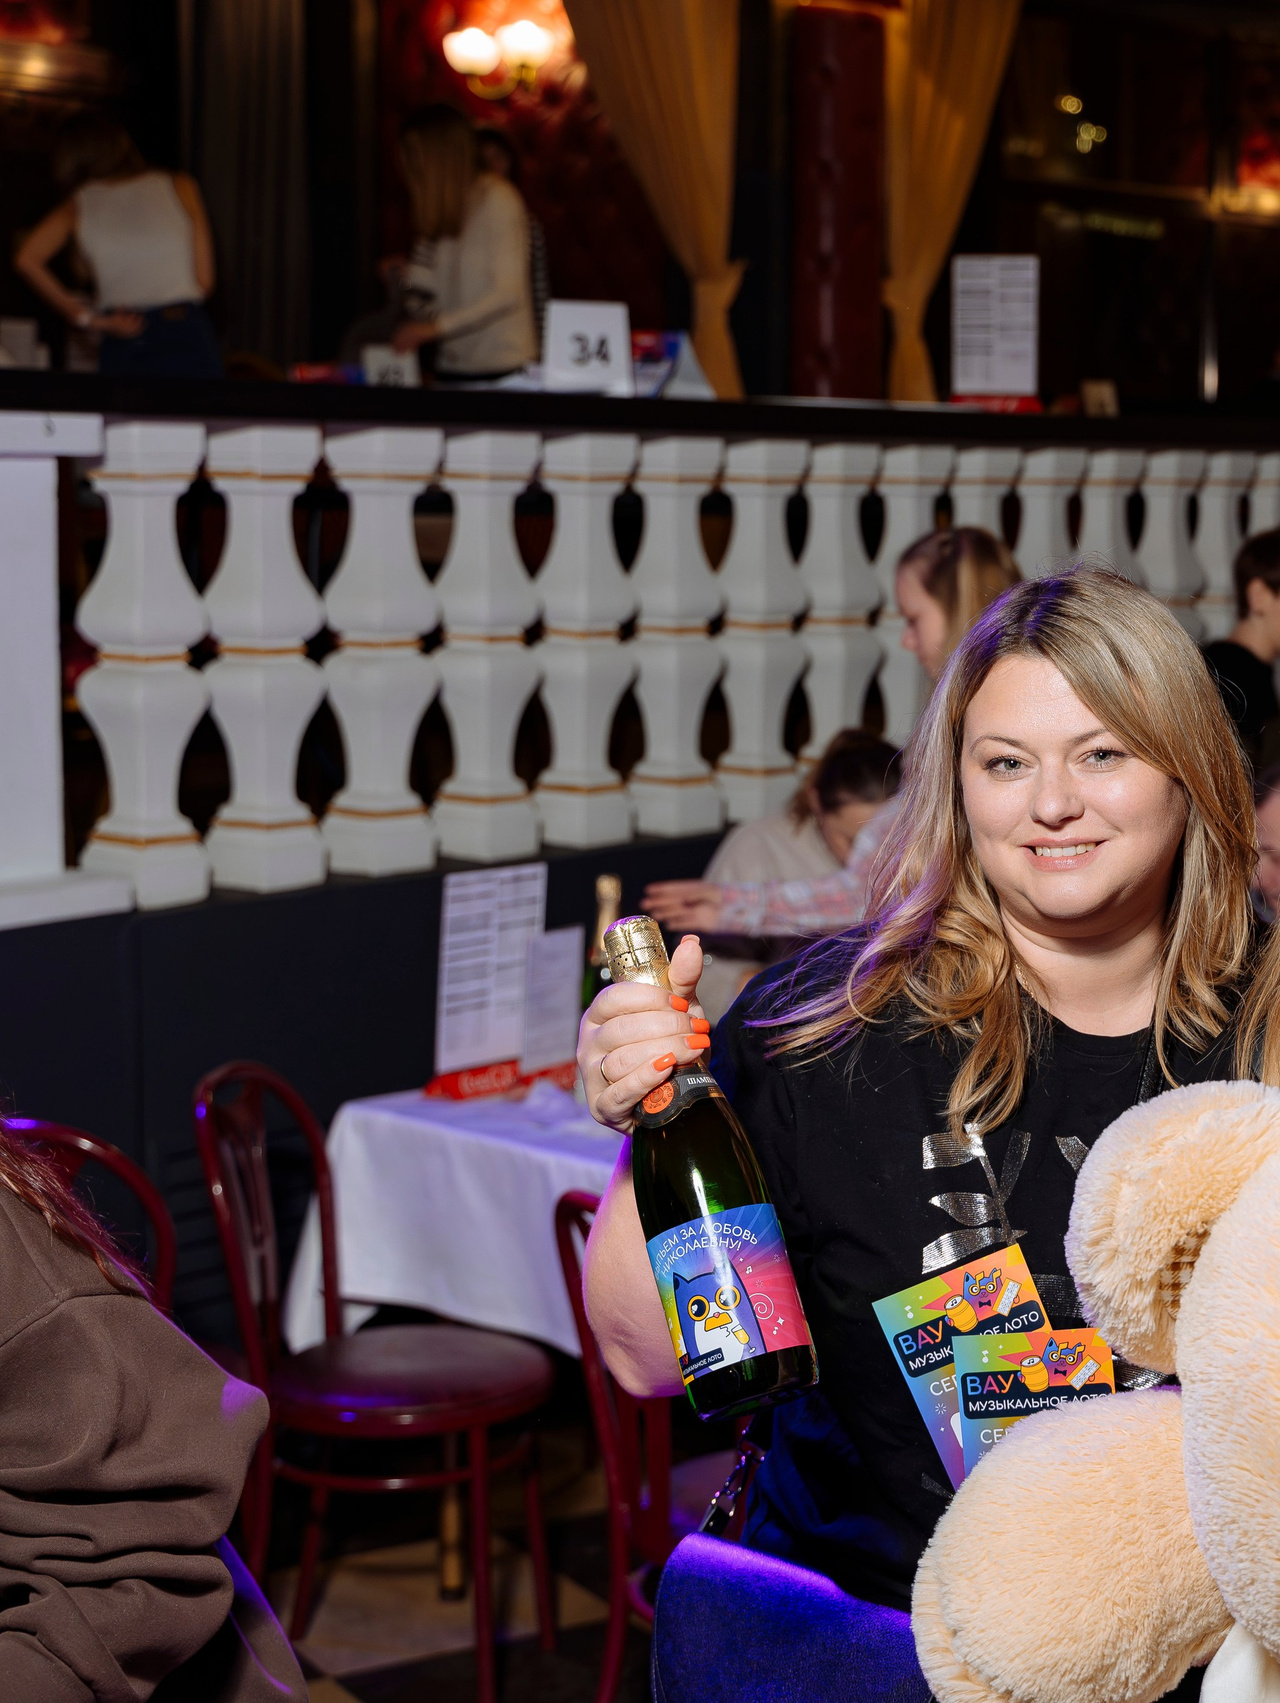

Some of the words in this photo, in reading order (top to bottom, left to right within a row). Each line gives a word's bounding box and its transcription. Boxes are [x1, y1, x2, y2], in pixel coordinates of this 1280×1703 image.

[570, 332, 611, 366] 34
[679, 1226, 697, 1240] ЗА
[661, 1236, 742, 1278] НИКОЛАЕВНУ!
[1005, 1311, 1039, 1333] ЛОТО
[898, 1320, 943, 1356] ВАУ
[966, 1373, 1015, 1396] ВАУ
